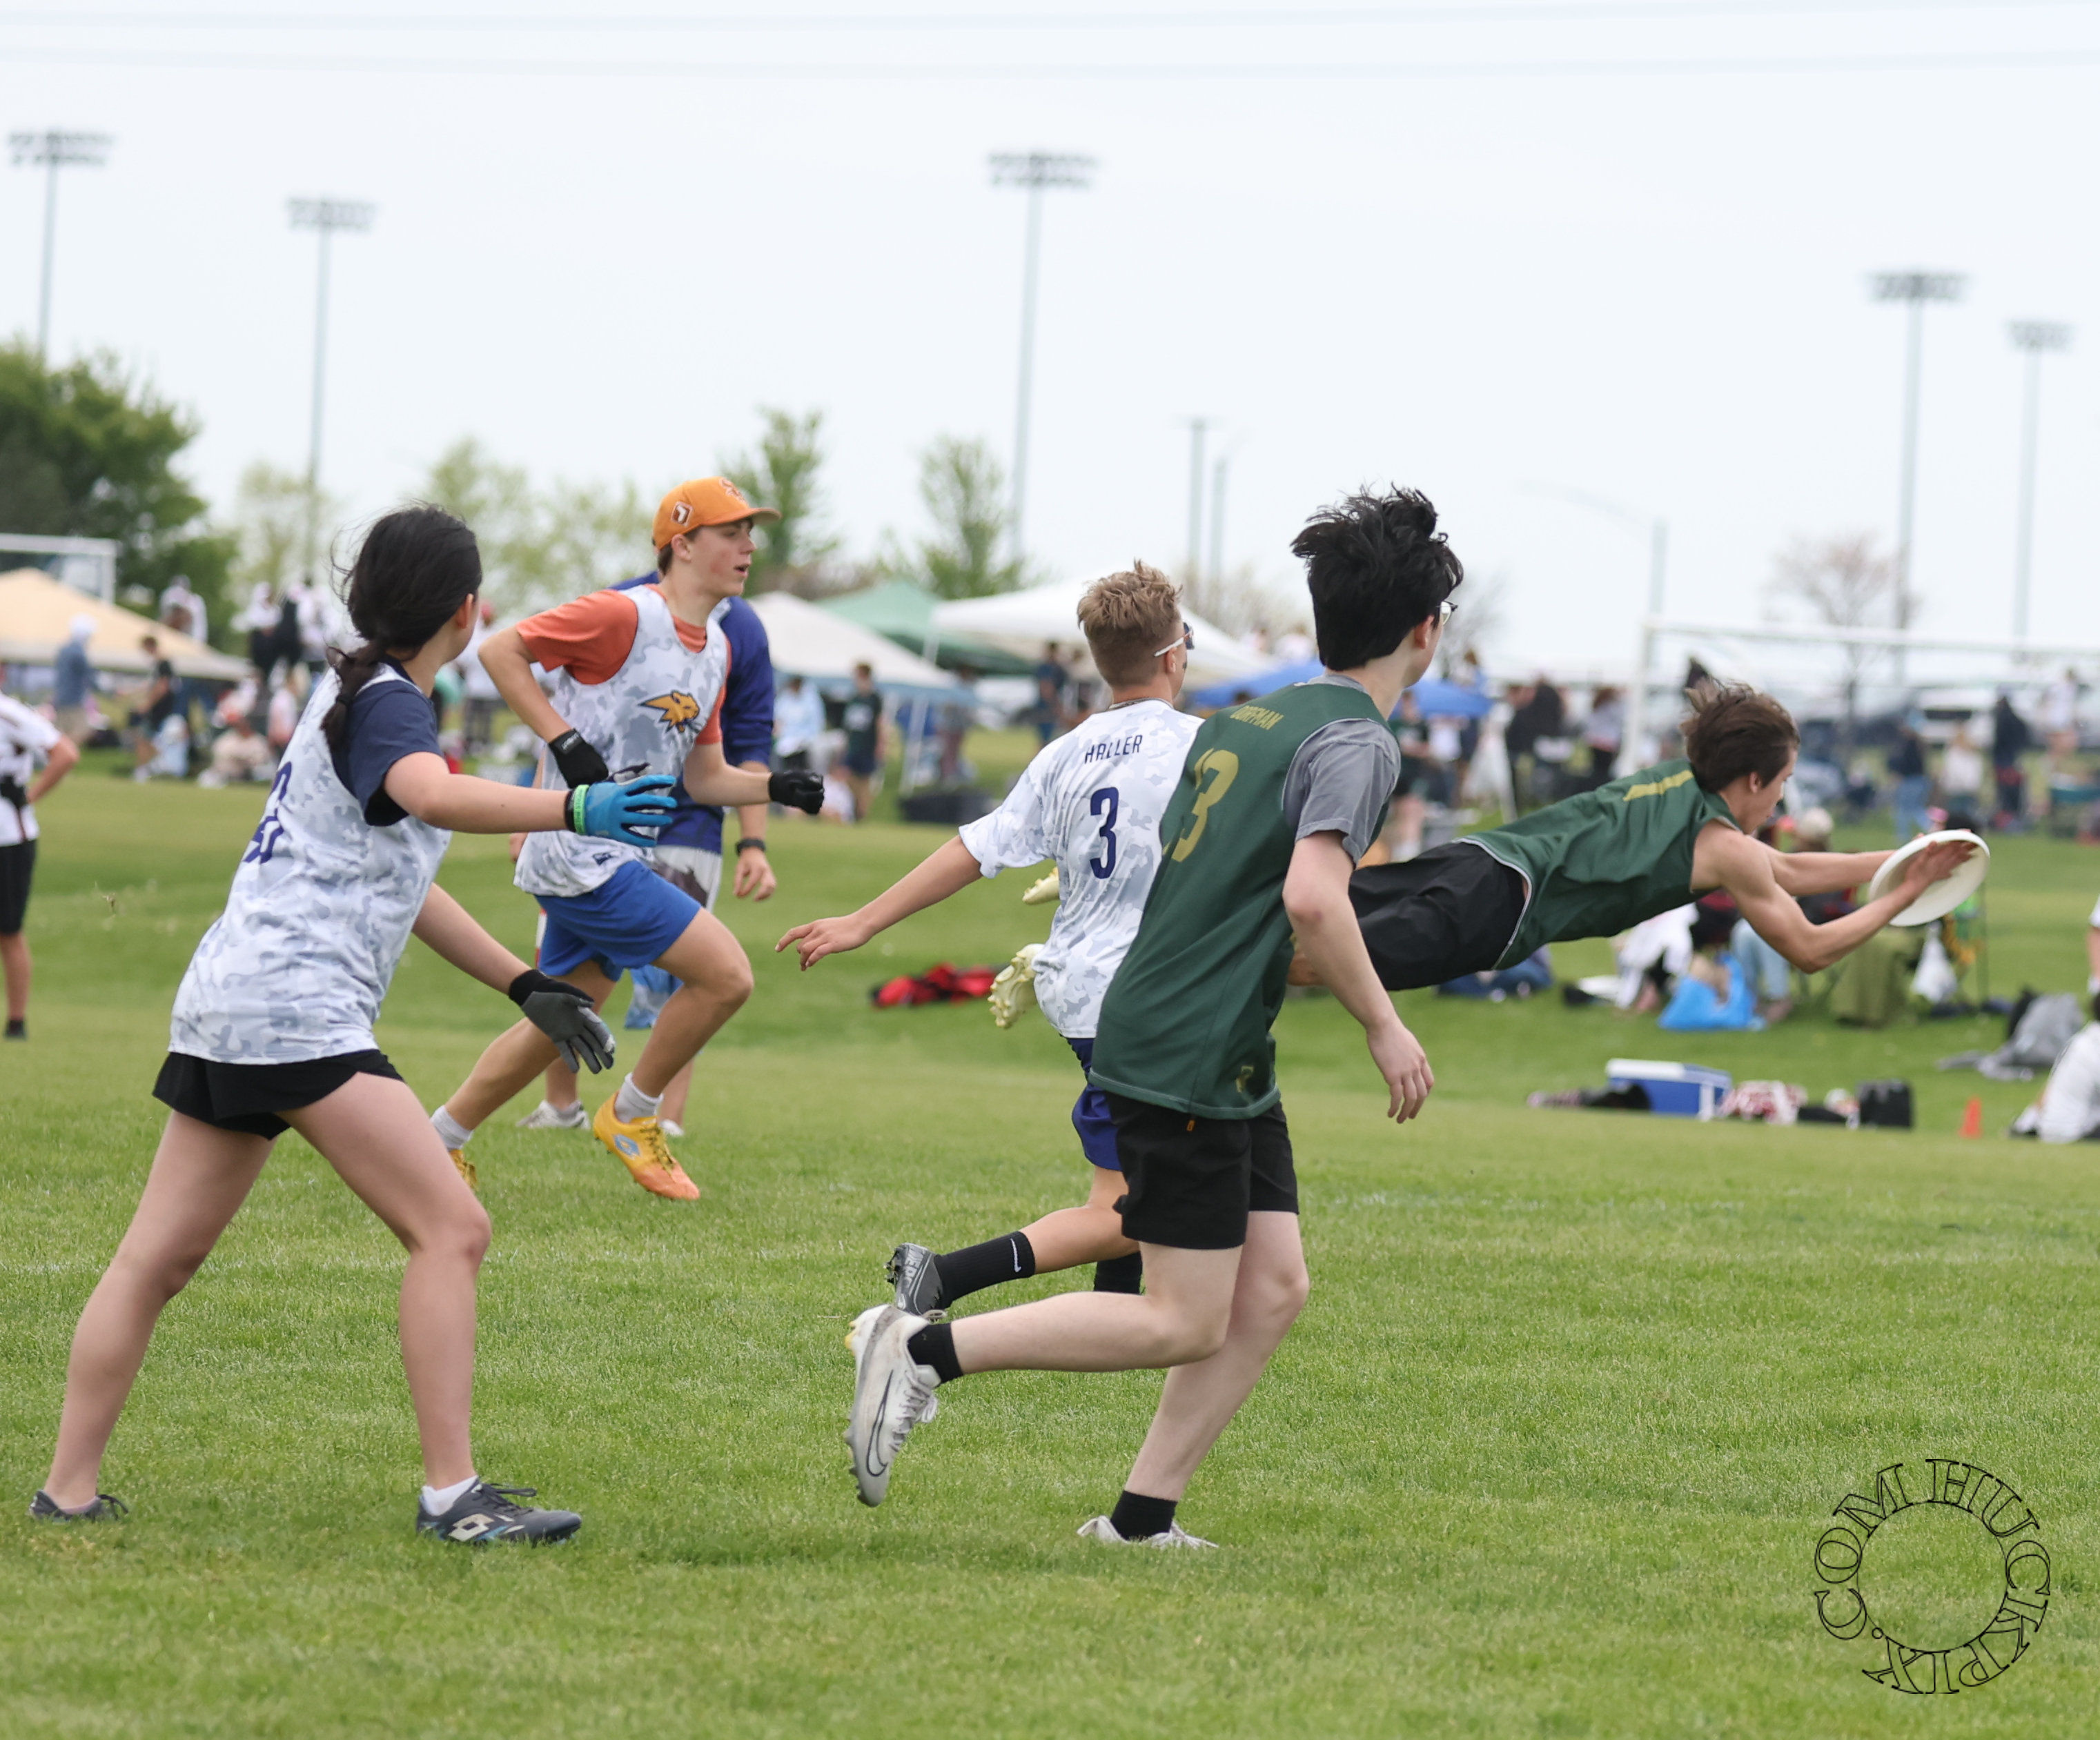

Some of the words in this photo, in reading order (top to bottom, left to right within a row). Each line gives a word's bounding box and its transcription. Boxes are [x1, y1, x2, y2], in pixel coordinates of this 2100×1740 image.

[1084, 734, 1144, 764] HALLER
[1090, 787, 1119, 880] 3
[1164, 747, 1239, 862] 3
